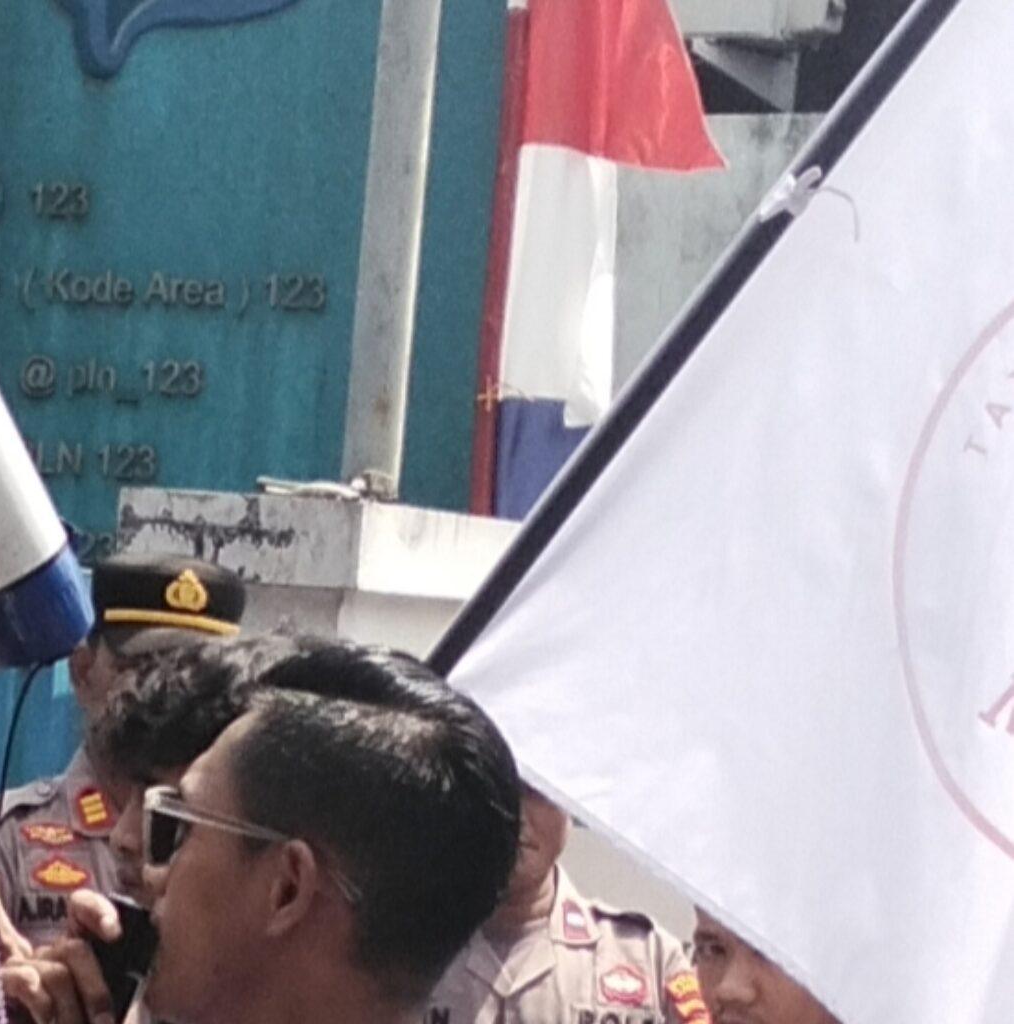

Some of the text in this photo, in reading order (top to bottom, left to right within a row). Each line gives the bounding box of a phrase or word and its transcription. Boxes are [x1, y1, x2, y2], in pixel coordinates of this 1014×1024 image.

[34, 182, 88, 218] 123
[49, 267, 134, 305] Kode
[145, 271, 226, 308] Area
[266, 272, 327, 312] 123
[68, 357, 203, 404] pln_123
[27, 440, 157, 480] LN 123
